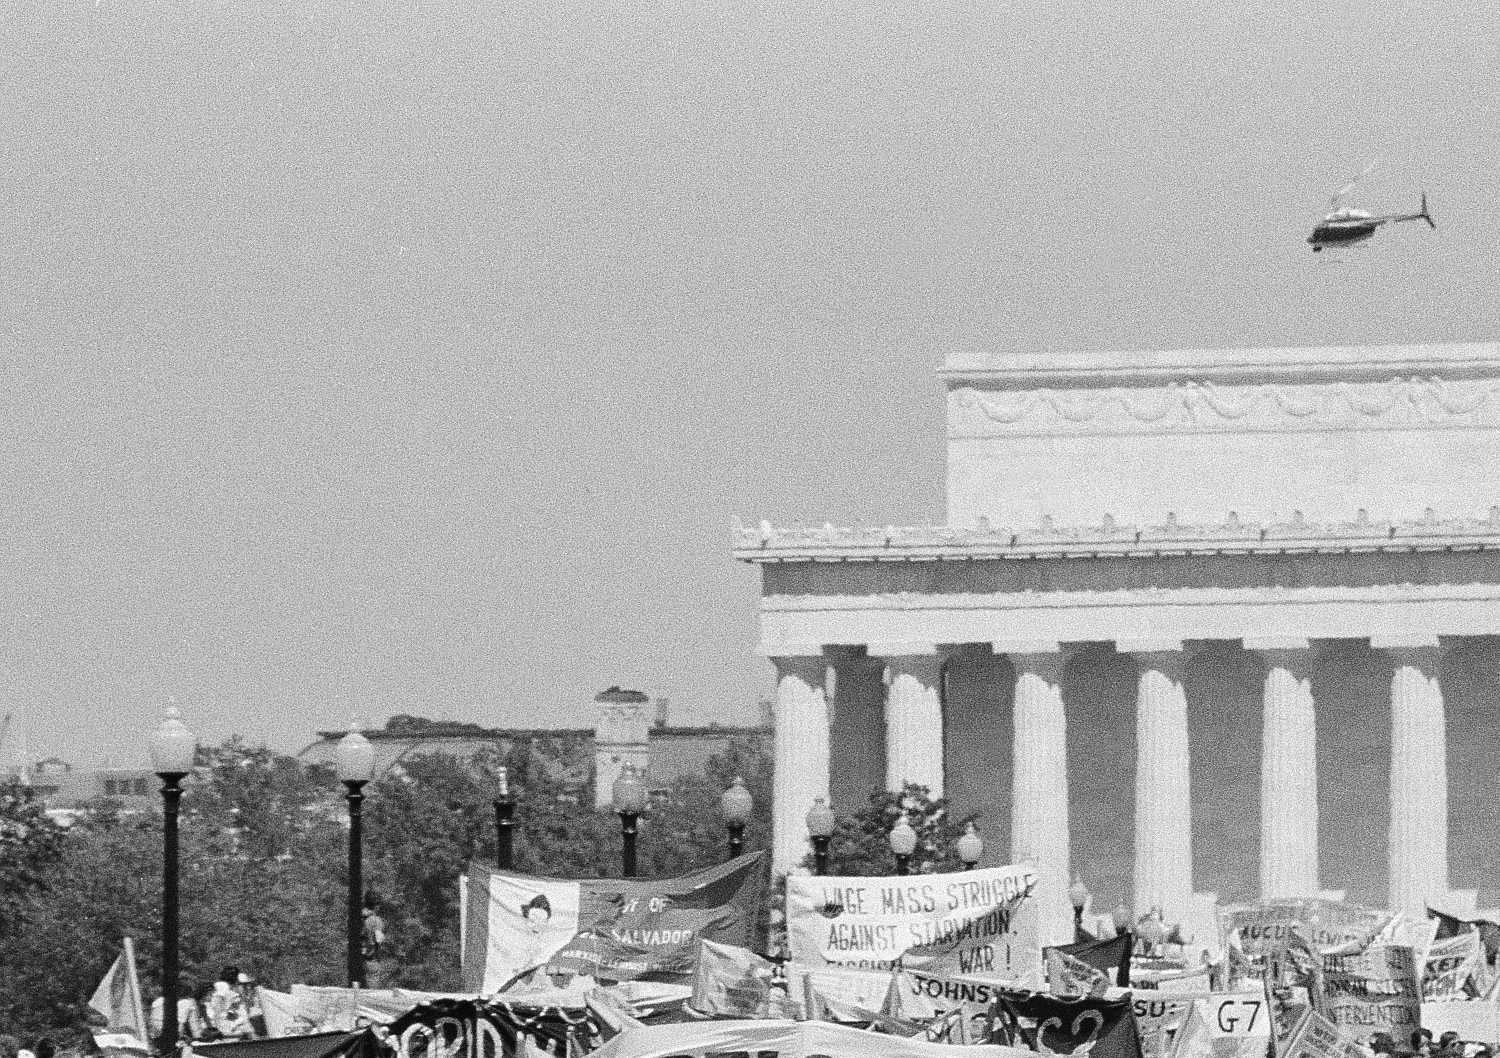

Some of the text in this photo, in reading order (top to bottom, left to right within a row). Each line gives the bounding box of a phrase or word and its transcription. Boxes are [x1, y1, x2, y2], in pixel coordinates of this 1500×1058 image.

[882, 885, 936, 914] MASS
[948, 873, 1034, 911] STRUGGLE
[827, 923, 898, 952] AGAINST
[958, 945, 994, 975] WAR
[1217, 1000, 1262, 1032] G7
